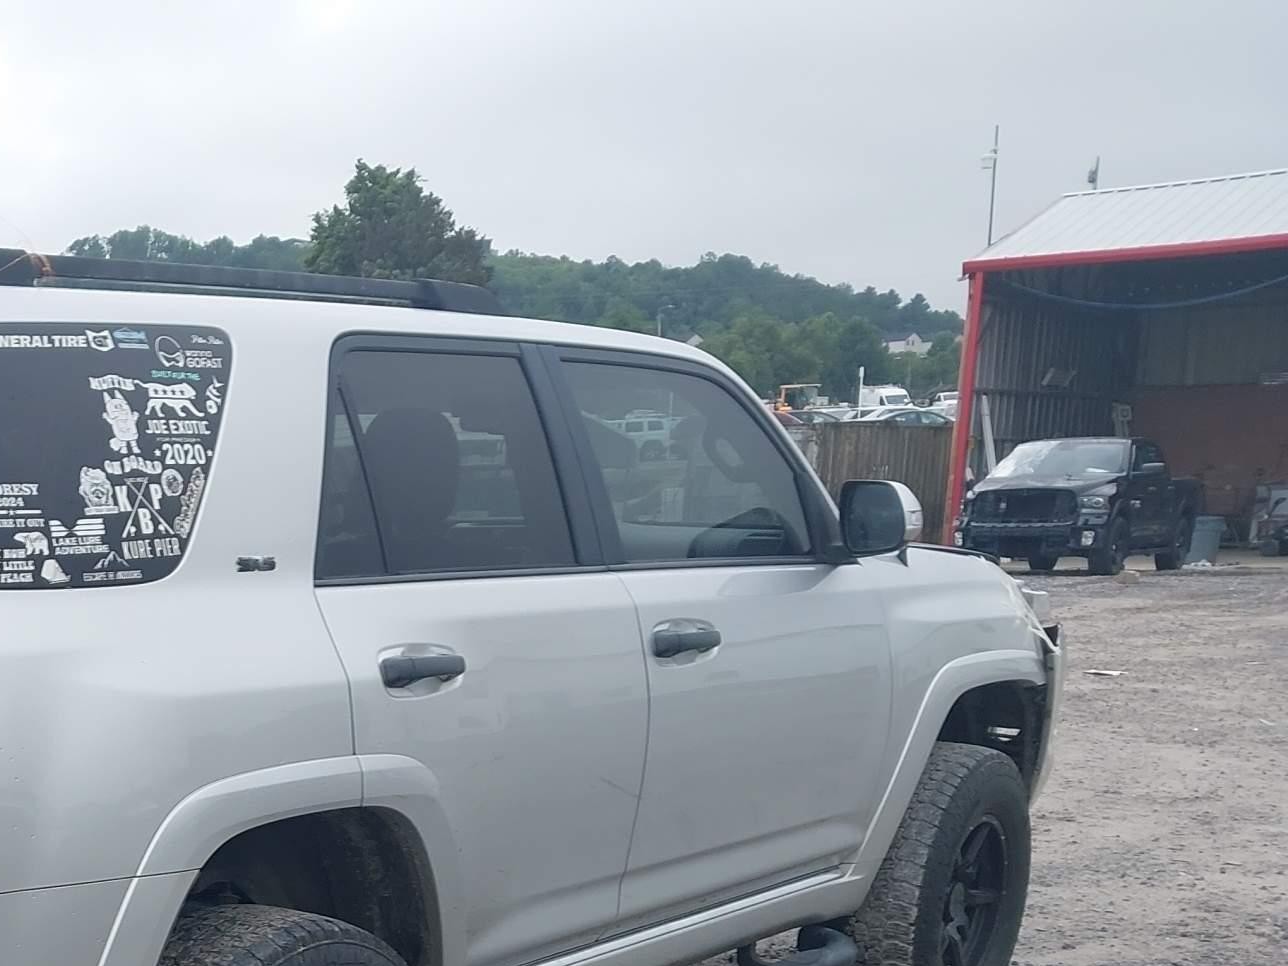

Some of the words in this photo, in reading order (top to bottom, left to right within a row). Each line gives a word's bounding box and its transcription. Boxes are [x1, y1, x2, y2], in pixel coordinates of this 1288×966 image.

[52, 335, 88, 348] TIRE
[145, 420, 169, 433] JOE
[169, 420, 211, 434] EXOTIC
[162, 443, 207, 464] 2020
[114, 485, 132, 512] K
[149, 483, 163, 510] P
[137, 508, 154, 534] B
[121, 540, 153, 560] KURE
[153, 537, 181, 557] PIER
